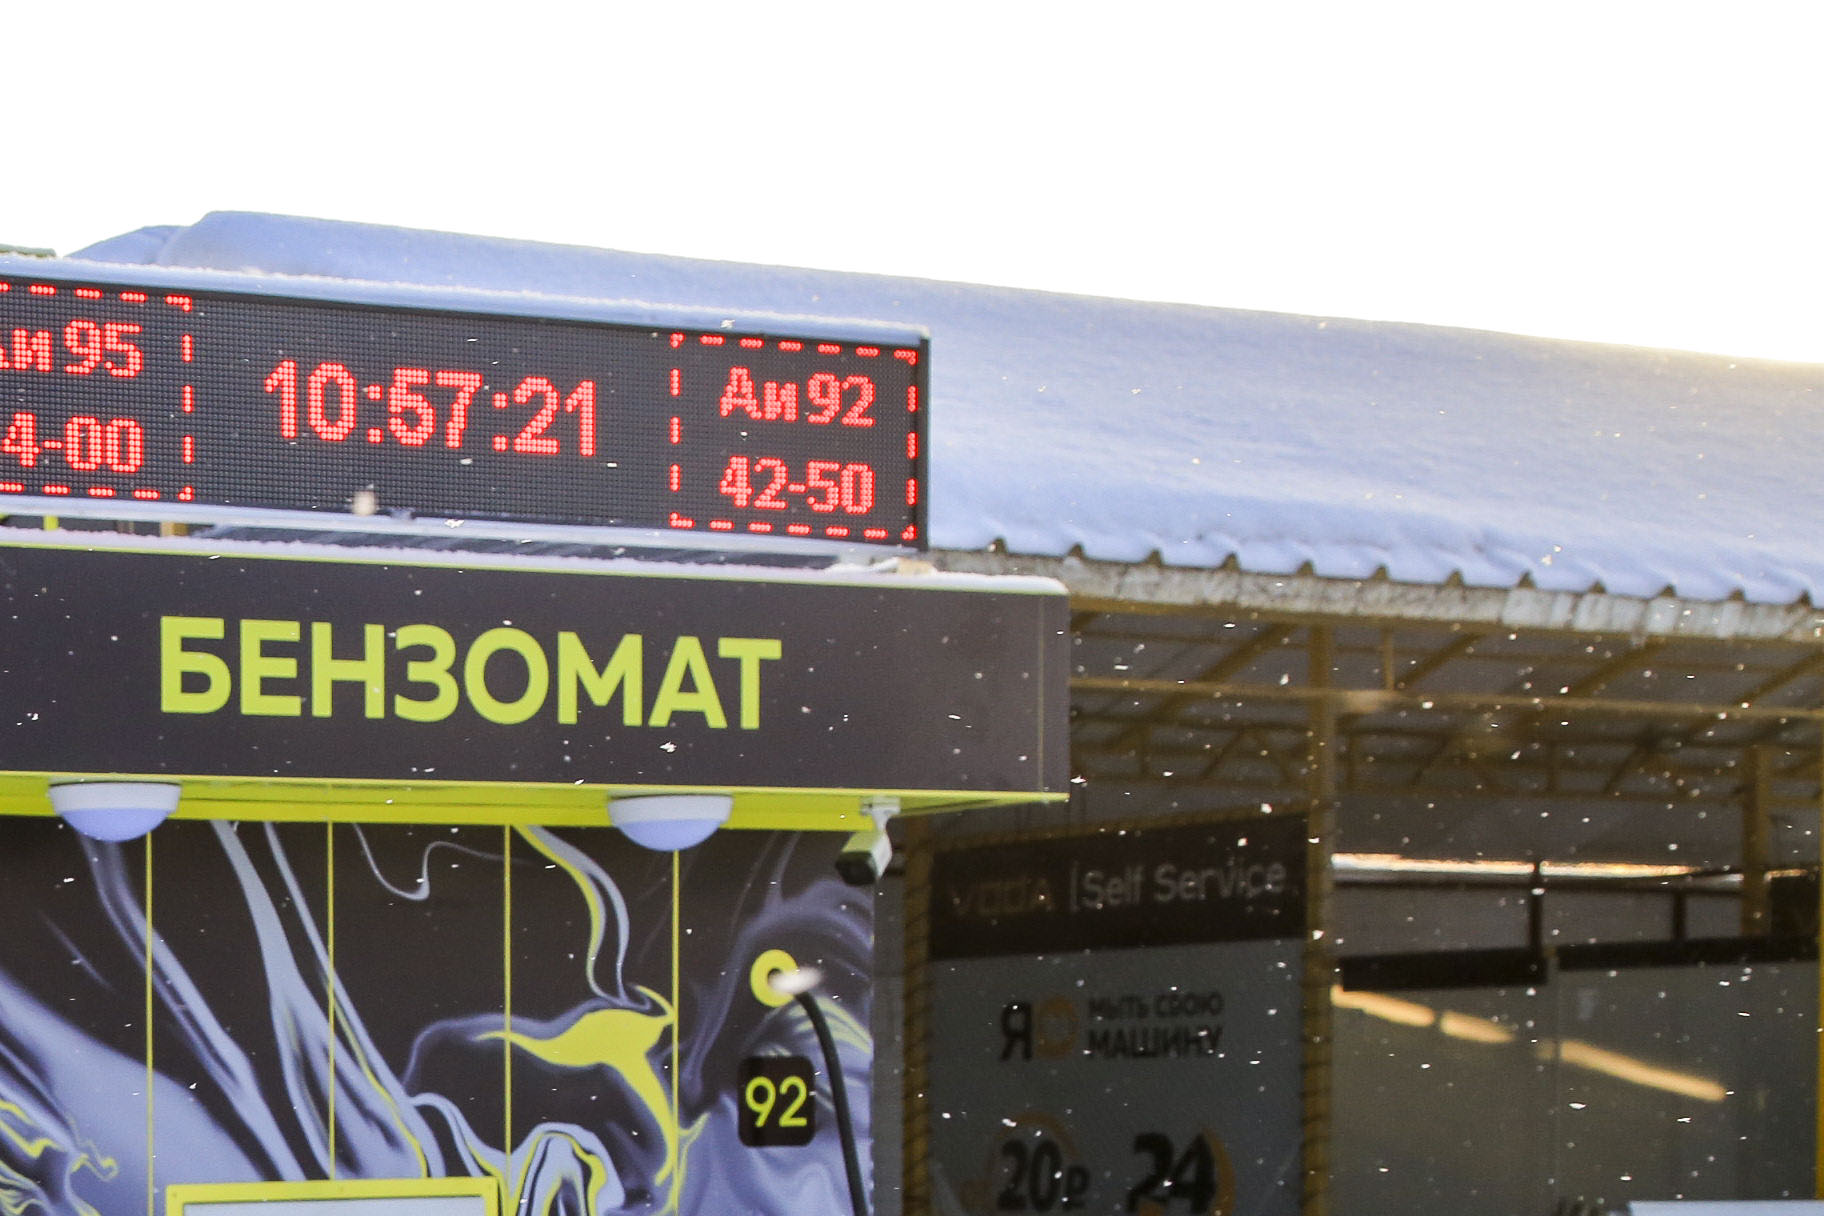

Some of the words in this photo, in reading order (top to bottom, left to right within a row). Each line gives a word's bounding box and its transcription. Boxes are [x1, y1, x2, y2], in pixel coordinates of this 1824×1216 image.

[264, 360, 597, 457] 10:57:21
[719, 456, 876, 515] 42-50
[159, 616, 782, 730] БЕНЗОМАТ
[1083, 868, 1144, 906] Self
[1153, 860, 1288, 901] Service
[999, 1002, 1033, 1060] Я
[1087, 1027, 1222, 1059] МАШИНУ
[745, 1075, 808, 1128] 92
[1126, 1132, 1216, 1214] 24
